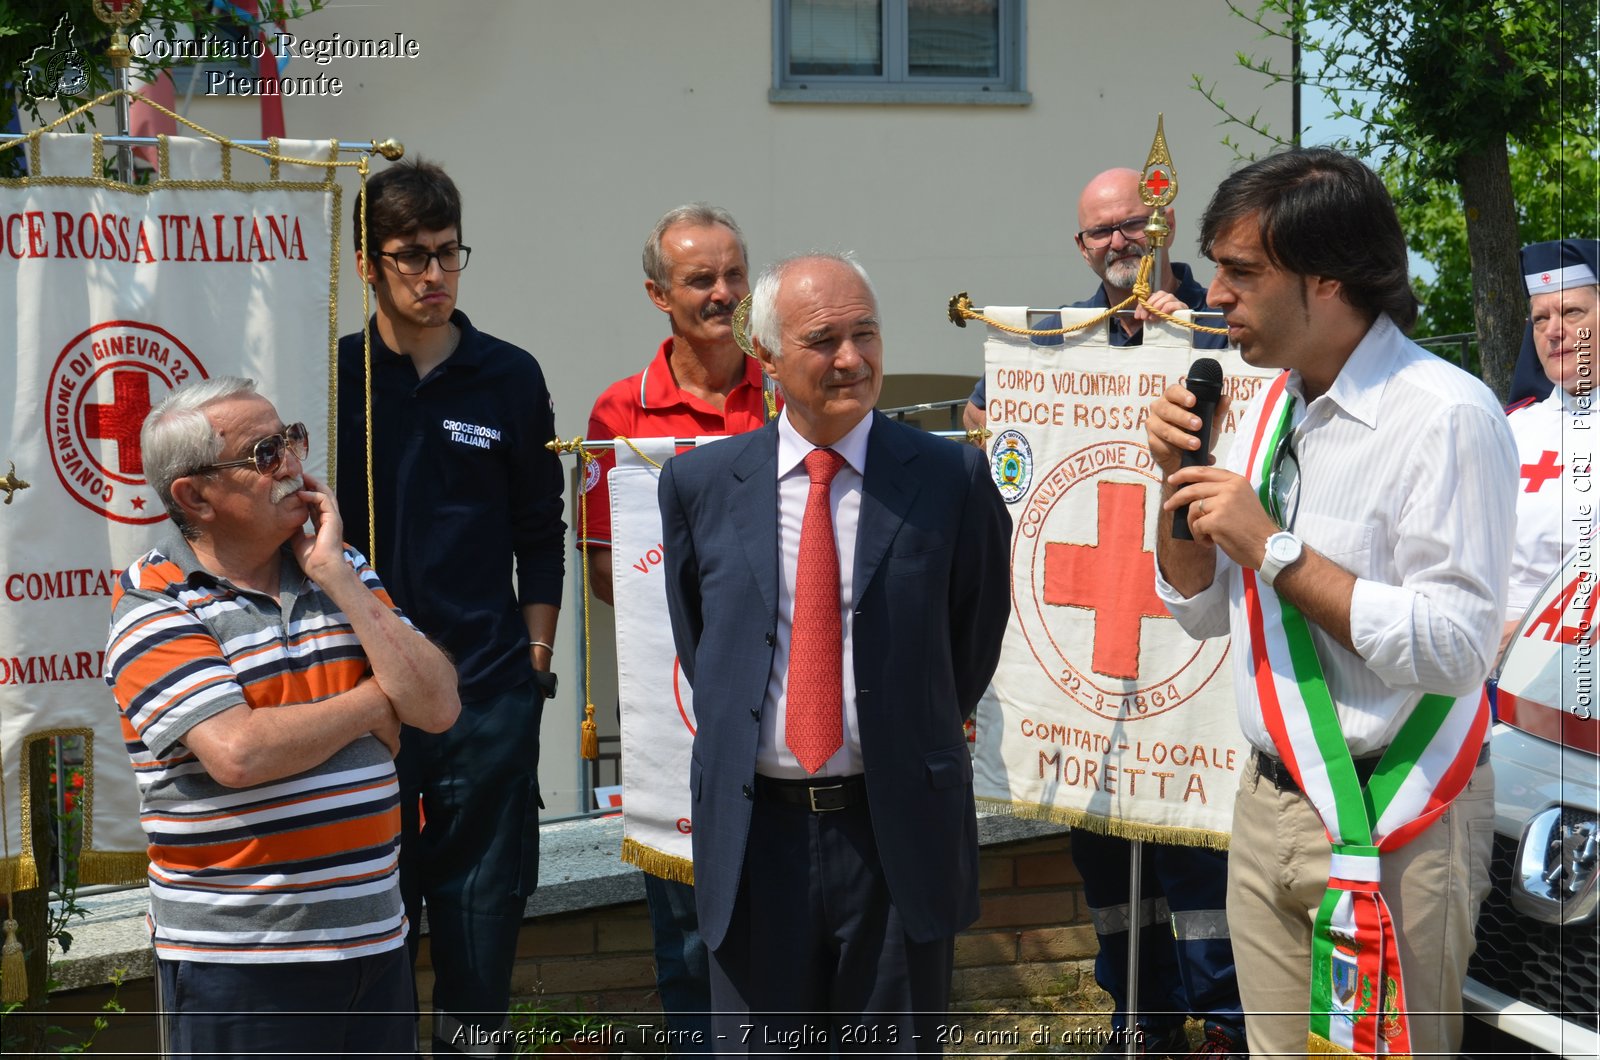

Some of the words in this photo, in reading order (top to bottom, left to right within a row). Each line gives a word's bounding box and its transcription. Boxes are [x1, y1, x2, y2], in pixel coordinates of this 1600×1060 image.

[0, 211, 48, 260] CE
[52, 211, 157, 264] ROSSA
[157, 214, 309, 263] ITALIANA
[69, 351, 93, 378] DI
[92, 335, 170, 367] GINEVRA
[996, 367, 1045, 394] CORPO
[1052, 373, 1131, 398] VOLONTARI
[988, 397, 1065, 427] CROCE
[1073, 402, 1150, 431] ROSSA
[56, 374, 114, 504] CONVENZIONE
[451, 431, 490, 449] ITALIANA
[1022, 446, 1127, 539] CONVENZIONE
[1020, 718, 1112, 755] COMITATO
[1136, 740, 1236, 771] LOCALE
[1038, 749, 1208, 805] MORETTA
